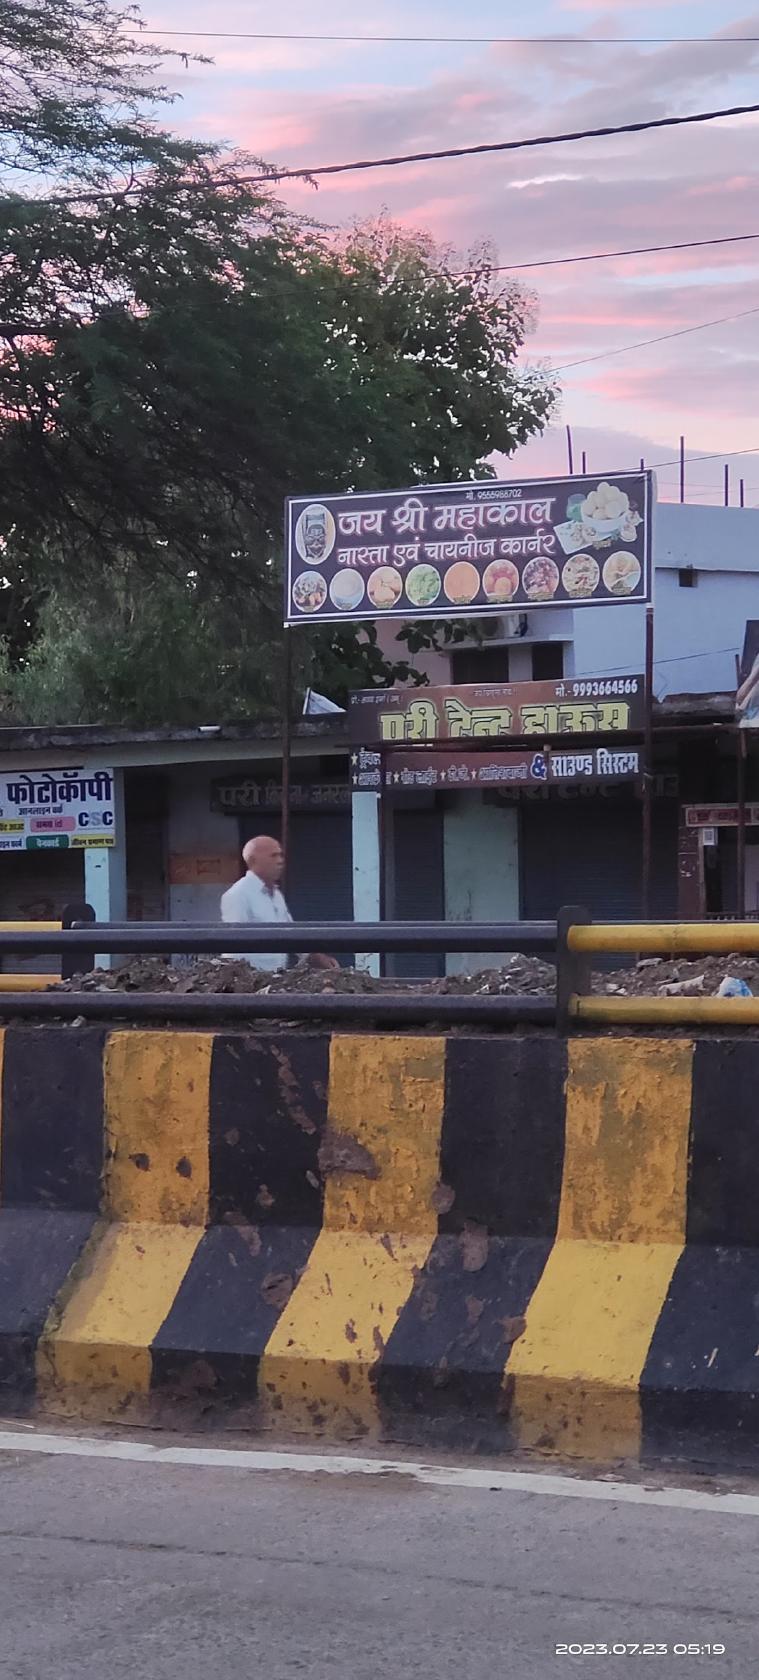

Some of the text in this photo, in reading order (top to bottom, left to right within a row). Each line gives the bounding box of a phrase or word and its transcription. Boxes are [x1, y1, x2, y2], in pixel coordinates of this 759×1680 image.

[338, 497, 556, 537] जय श्री महाकाल
[337, 529, 557, 567] नास्ता एवं चायनीज कार्नर
[380, 700, 439, 741] परी
[530, 748, 639, 780] & साउण्ड सिस्टम
[6, 771, 113, 804] फोटोकॉपी
[78, 811, 113, 827] CSC
